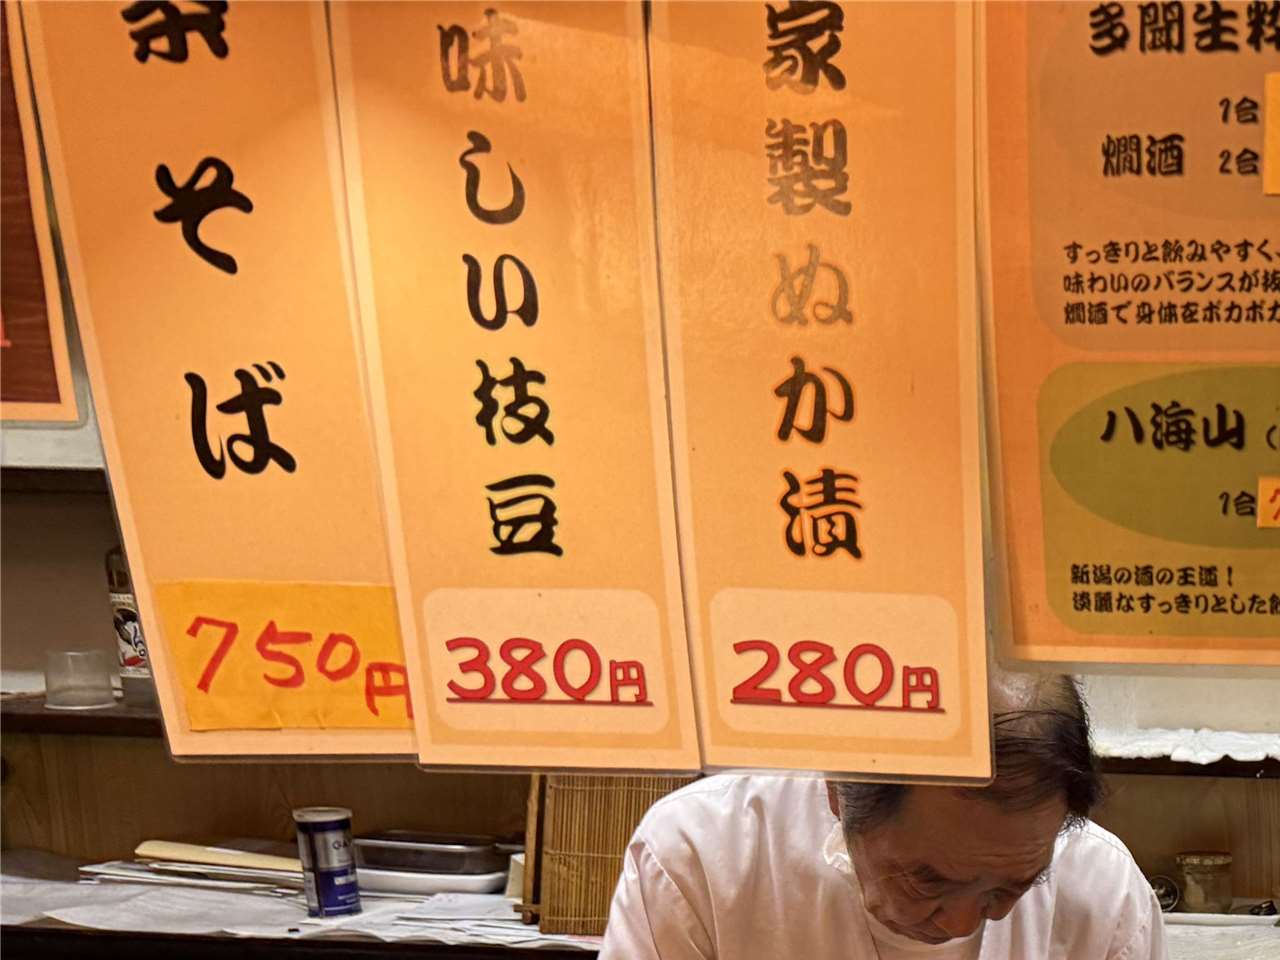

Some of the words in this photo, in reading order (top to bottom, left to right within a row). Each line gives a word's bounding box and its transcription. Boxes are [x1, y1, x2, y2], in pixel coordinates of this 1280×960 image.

[1218, 96, 1260, 124] 1合
[1218, 148, 1260, 175] 2合
[436, 8, 563, 558] 味しい枝豆
[1100, 401, 1246, 452] 八海山
[1219, 490, 1256, 518] 1合
[446, 636, 648, 703] 380円
[732, 639, 941, 709] 280円
